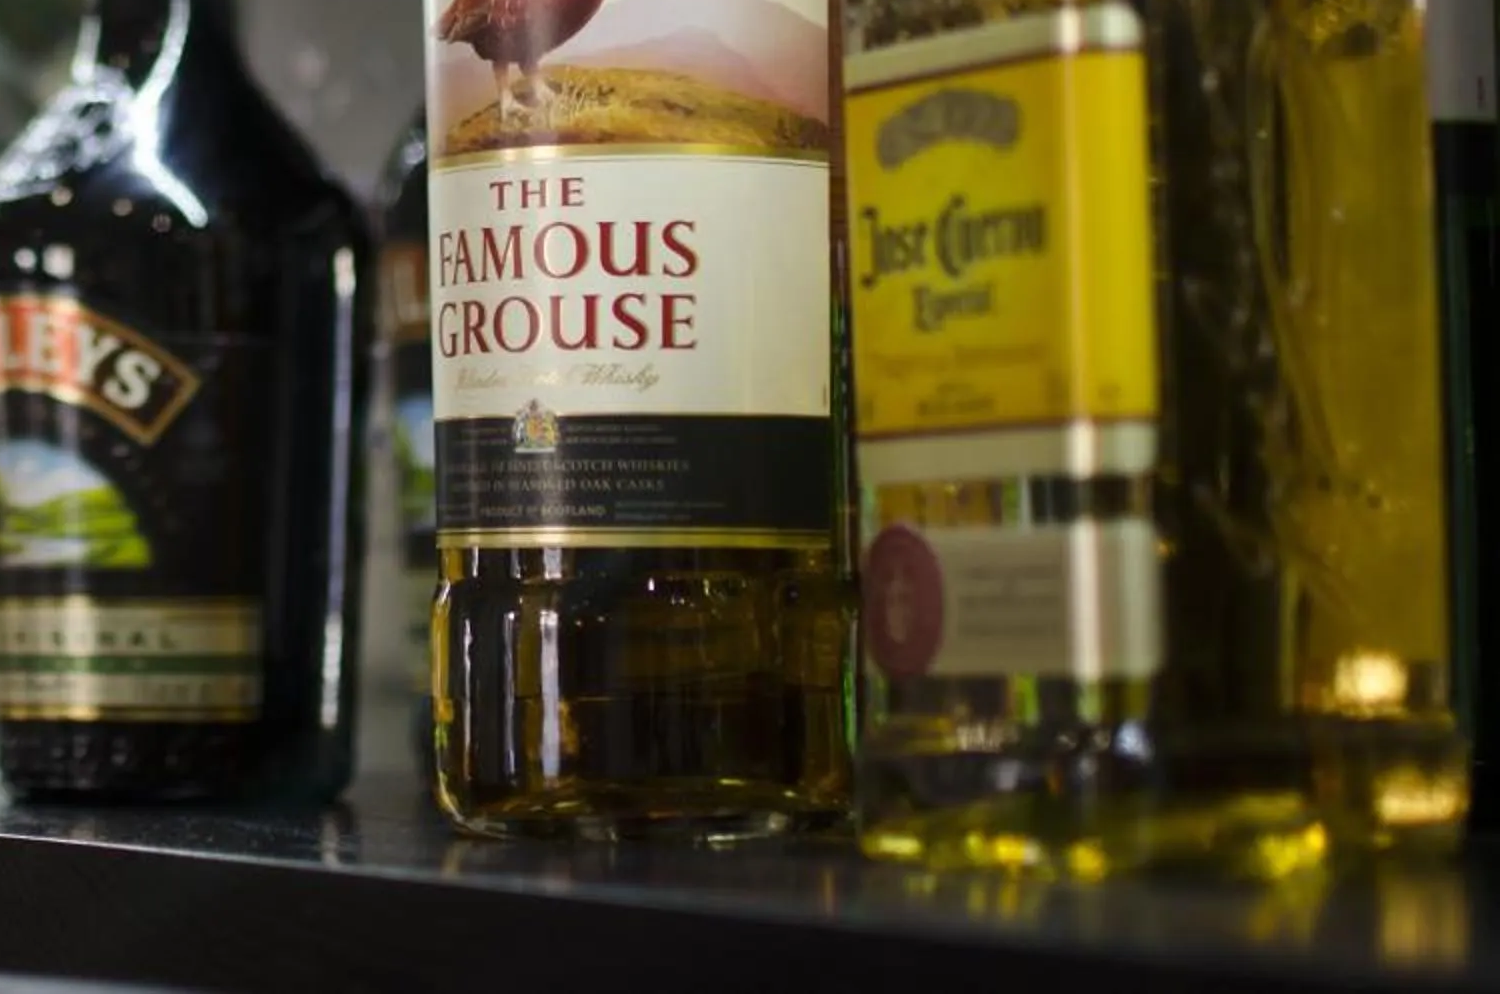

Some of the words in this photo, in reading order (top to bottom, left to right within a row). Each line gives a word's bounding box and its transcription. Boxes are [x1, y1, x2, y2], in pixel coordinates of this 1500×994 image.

[489, 177, 585, 210] THE
[440, 220, 698, 287] FAMOUS
[439, 294, 698, 358] GROUSE
